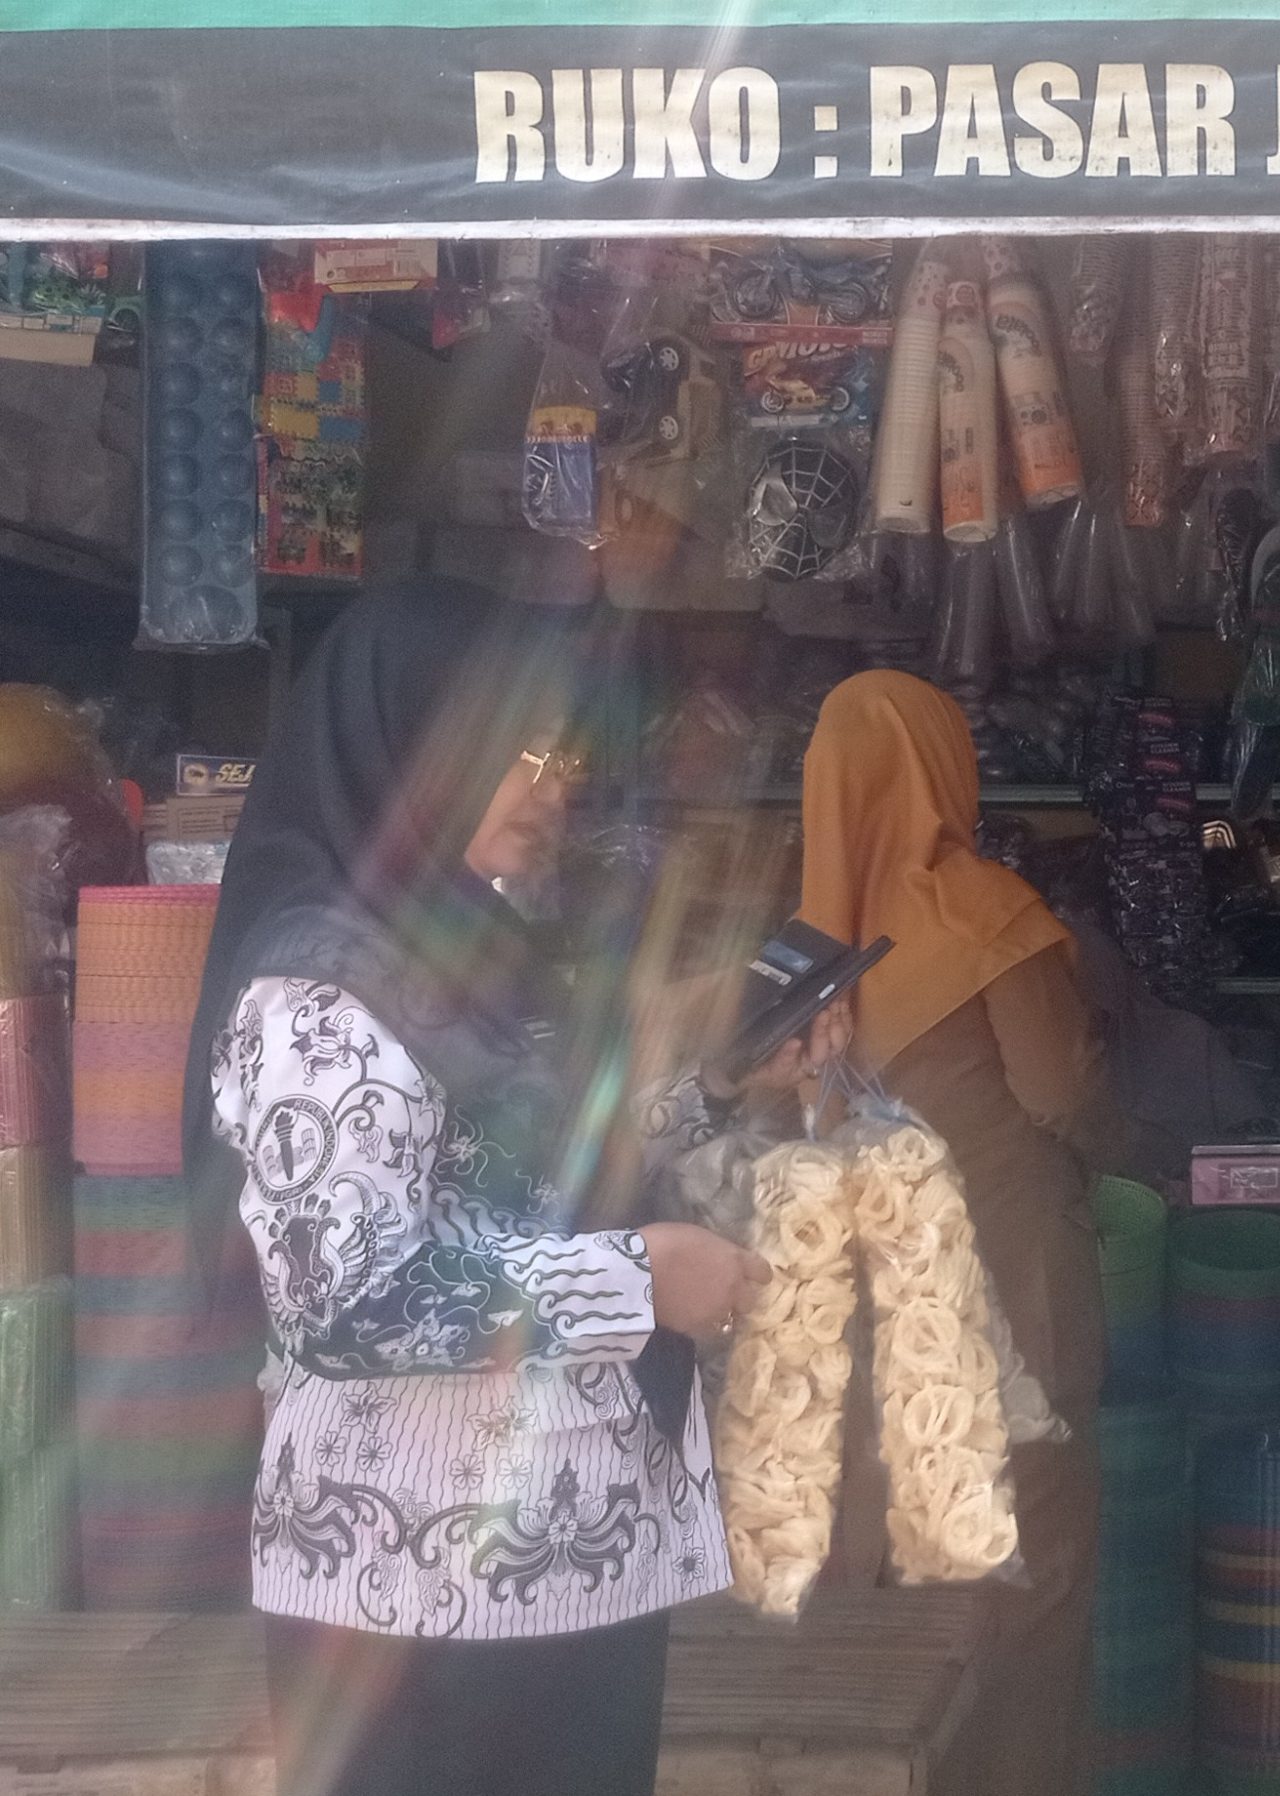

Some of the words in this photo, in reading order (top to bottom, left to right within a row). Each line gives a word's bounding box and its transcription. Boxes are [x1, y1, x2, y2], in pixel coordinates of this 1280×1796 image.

[473, 67, 781, 184] RUKO
[813, 105, 838, 179] :
[866, 62, 1236, 180] PASAR
[215, 763, 257, 782] SEJ
